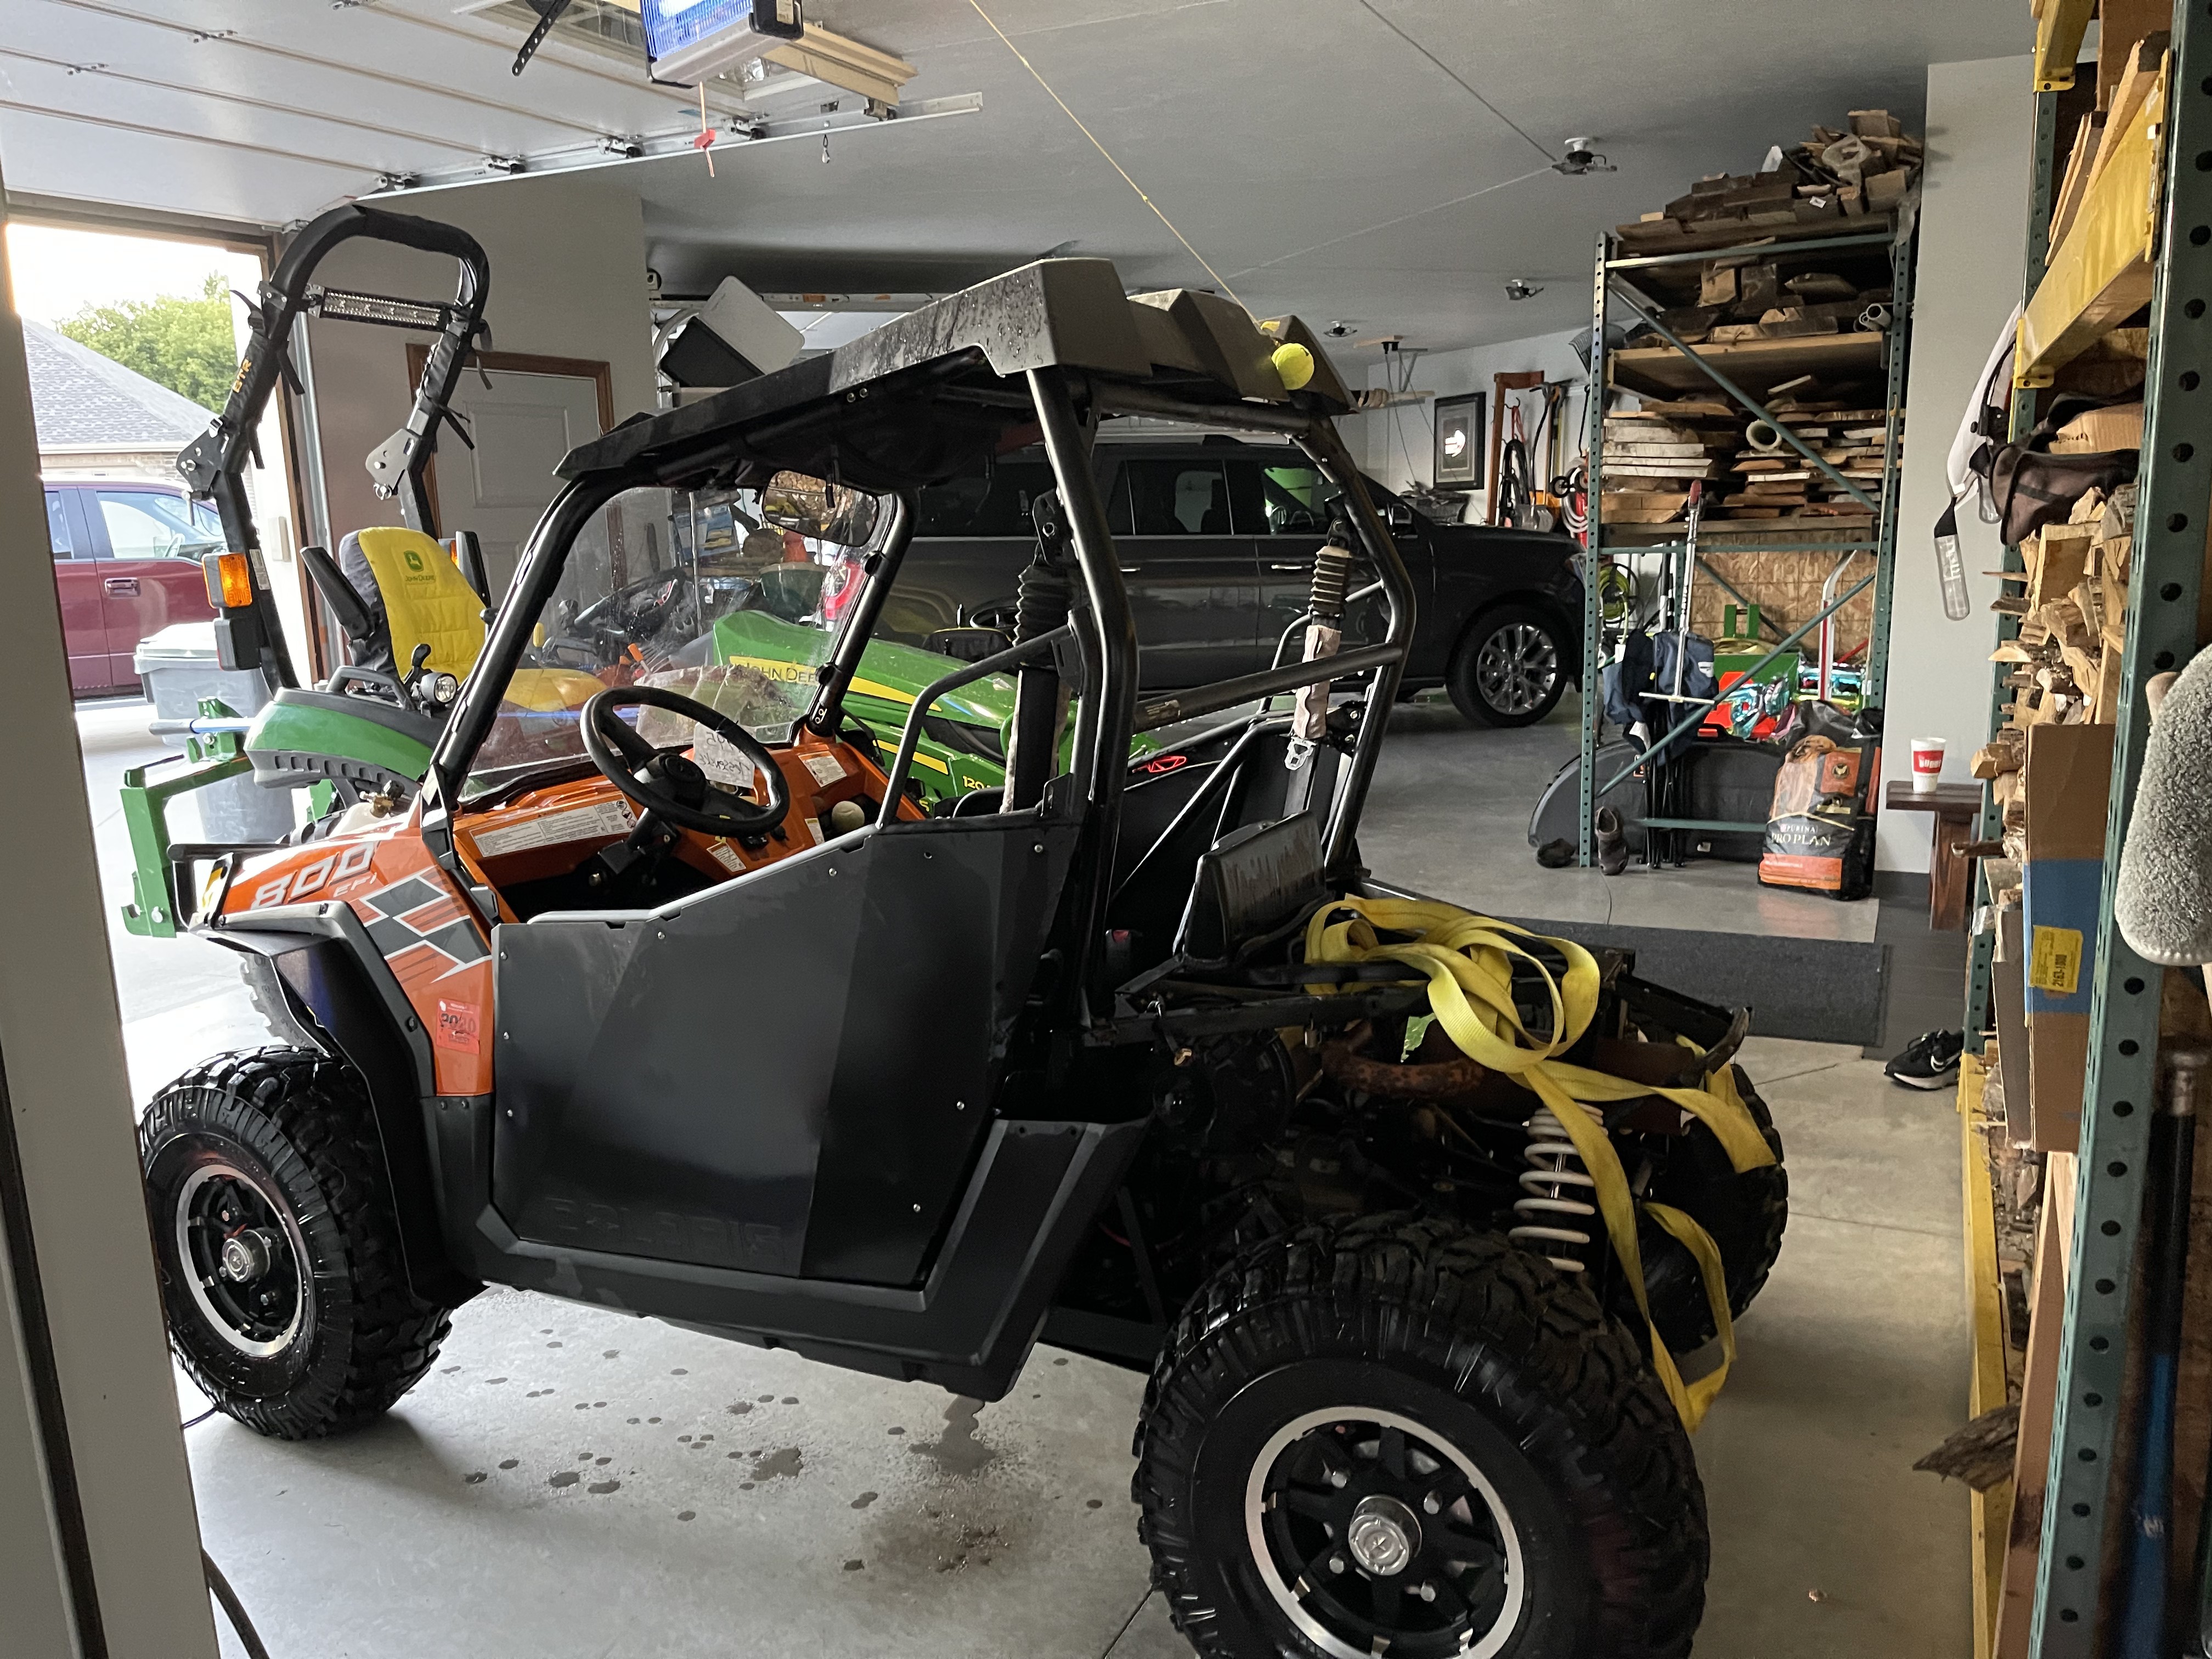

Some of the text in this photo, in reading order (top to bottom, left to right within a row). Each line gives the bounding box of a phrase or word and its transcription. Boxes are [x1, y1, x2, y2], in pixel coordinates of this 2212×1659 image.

[962, 775, 991, 790] 120
[1786, 825, 1816, 833] PURINA
[1771, 831, 1831, 847] PRO PLAN
[250, 842, 374, 911] 800
[333, 872, 377, 898] EFI
